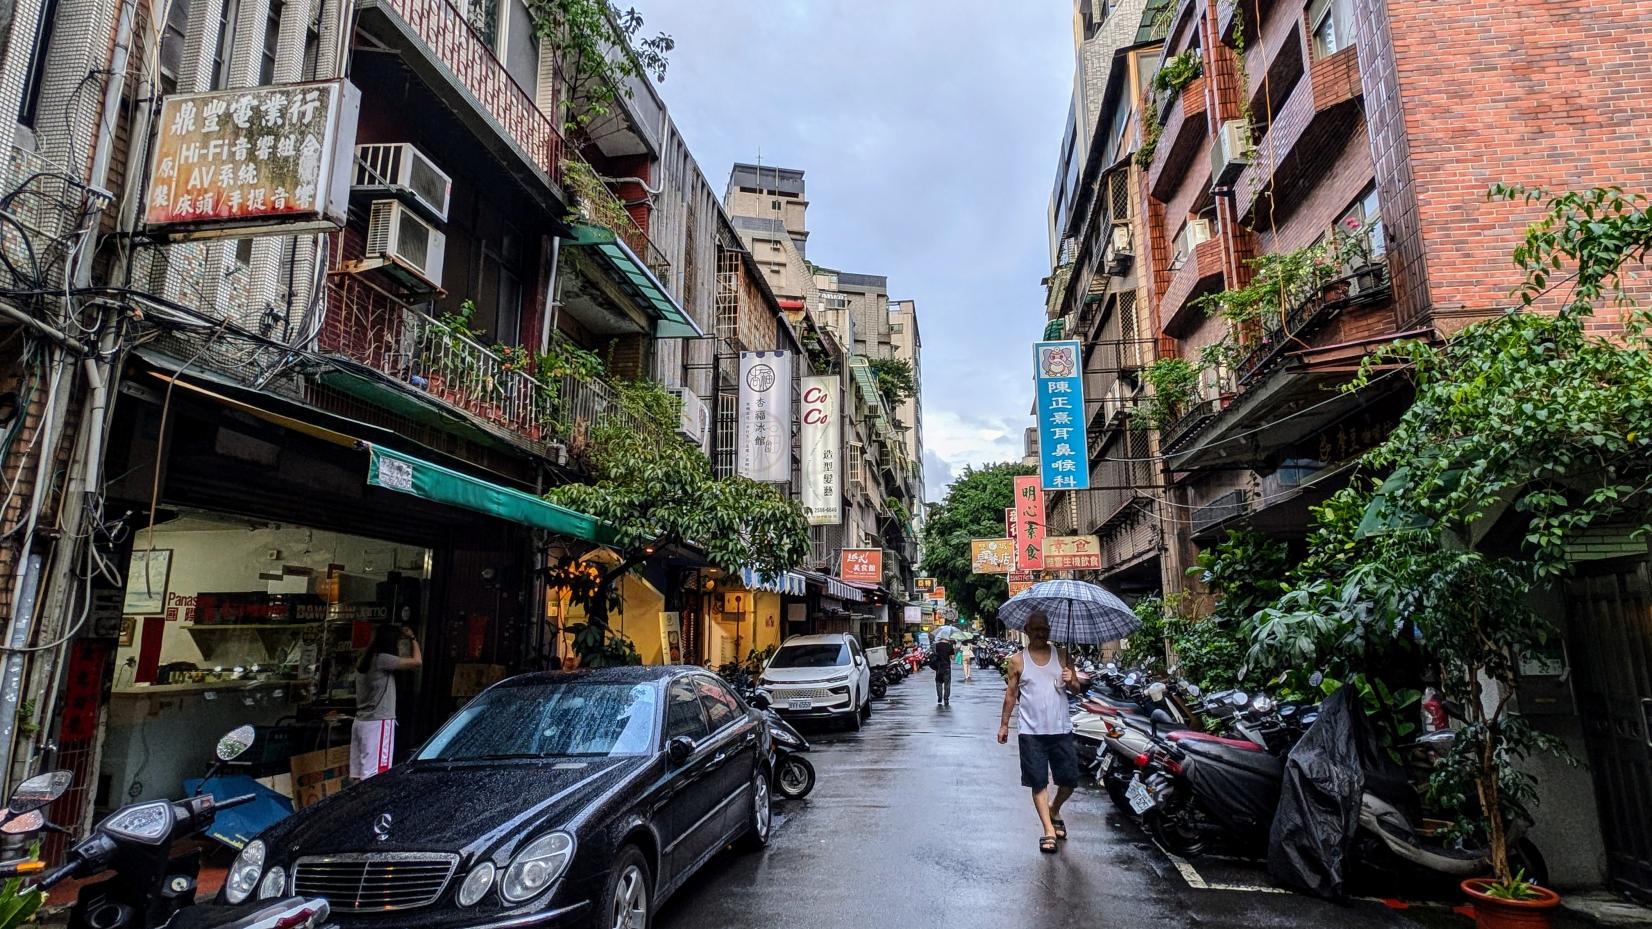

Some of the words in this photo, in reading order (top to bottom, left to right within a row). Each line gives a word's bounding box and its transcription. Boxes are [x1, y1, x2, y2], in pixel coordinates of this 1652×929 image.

[1022, 486, 1041, 561] 明心素食
[168, 592, 199, 607] Panas
